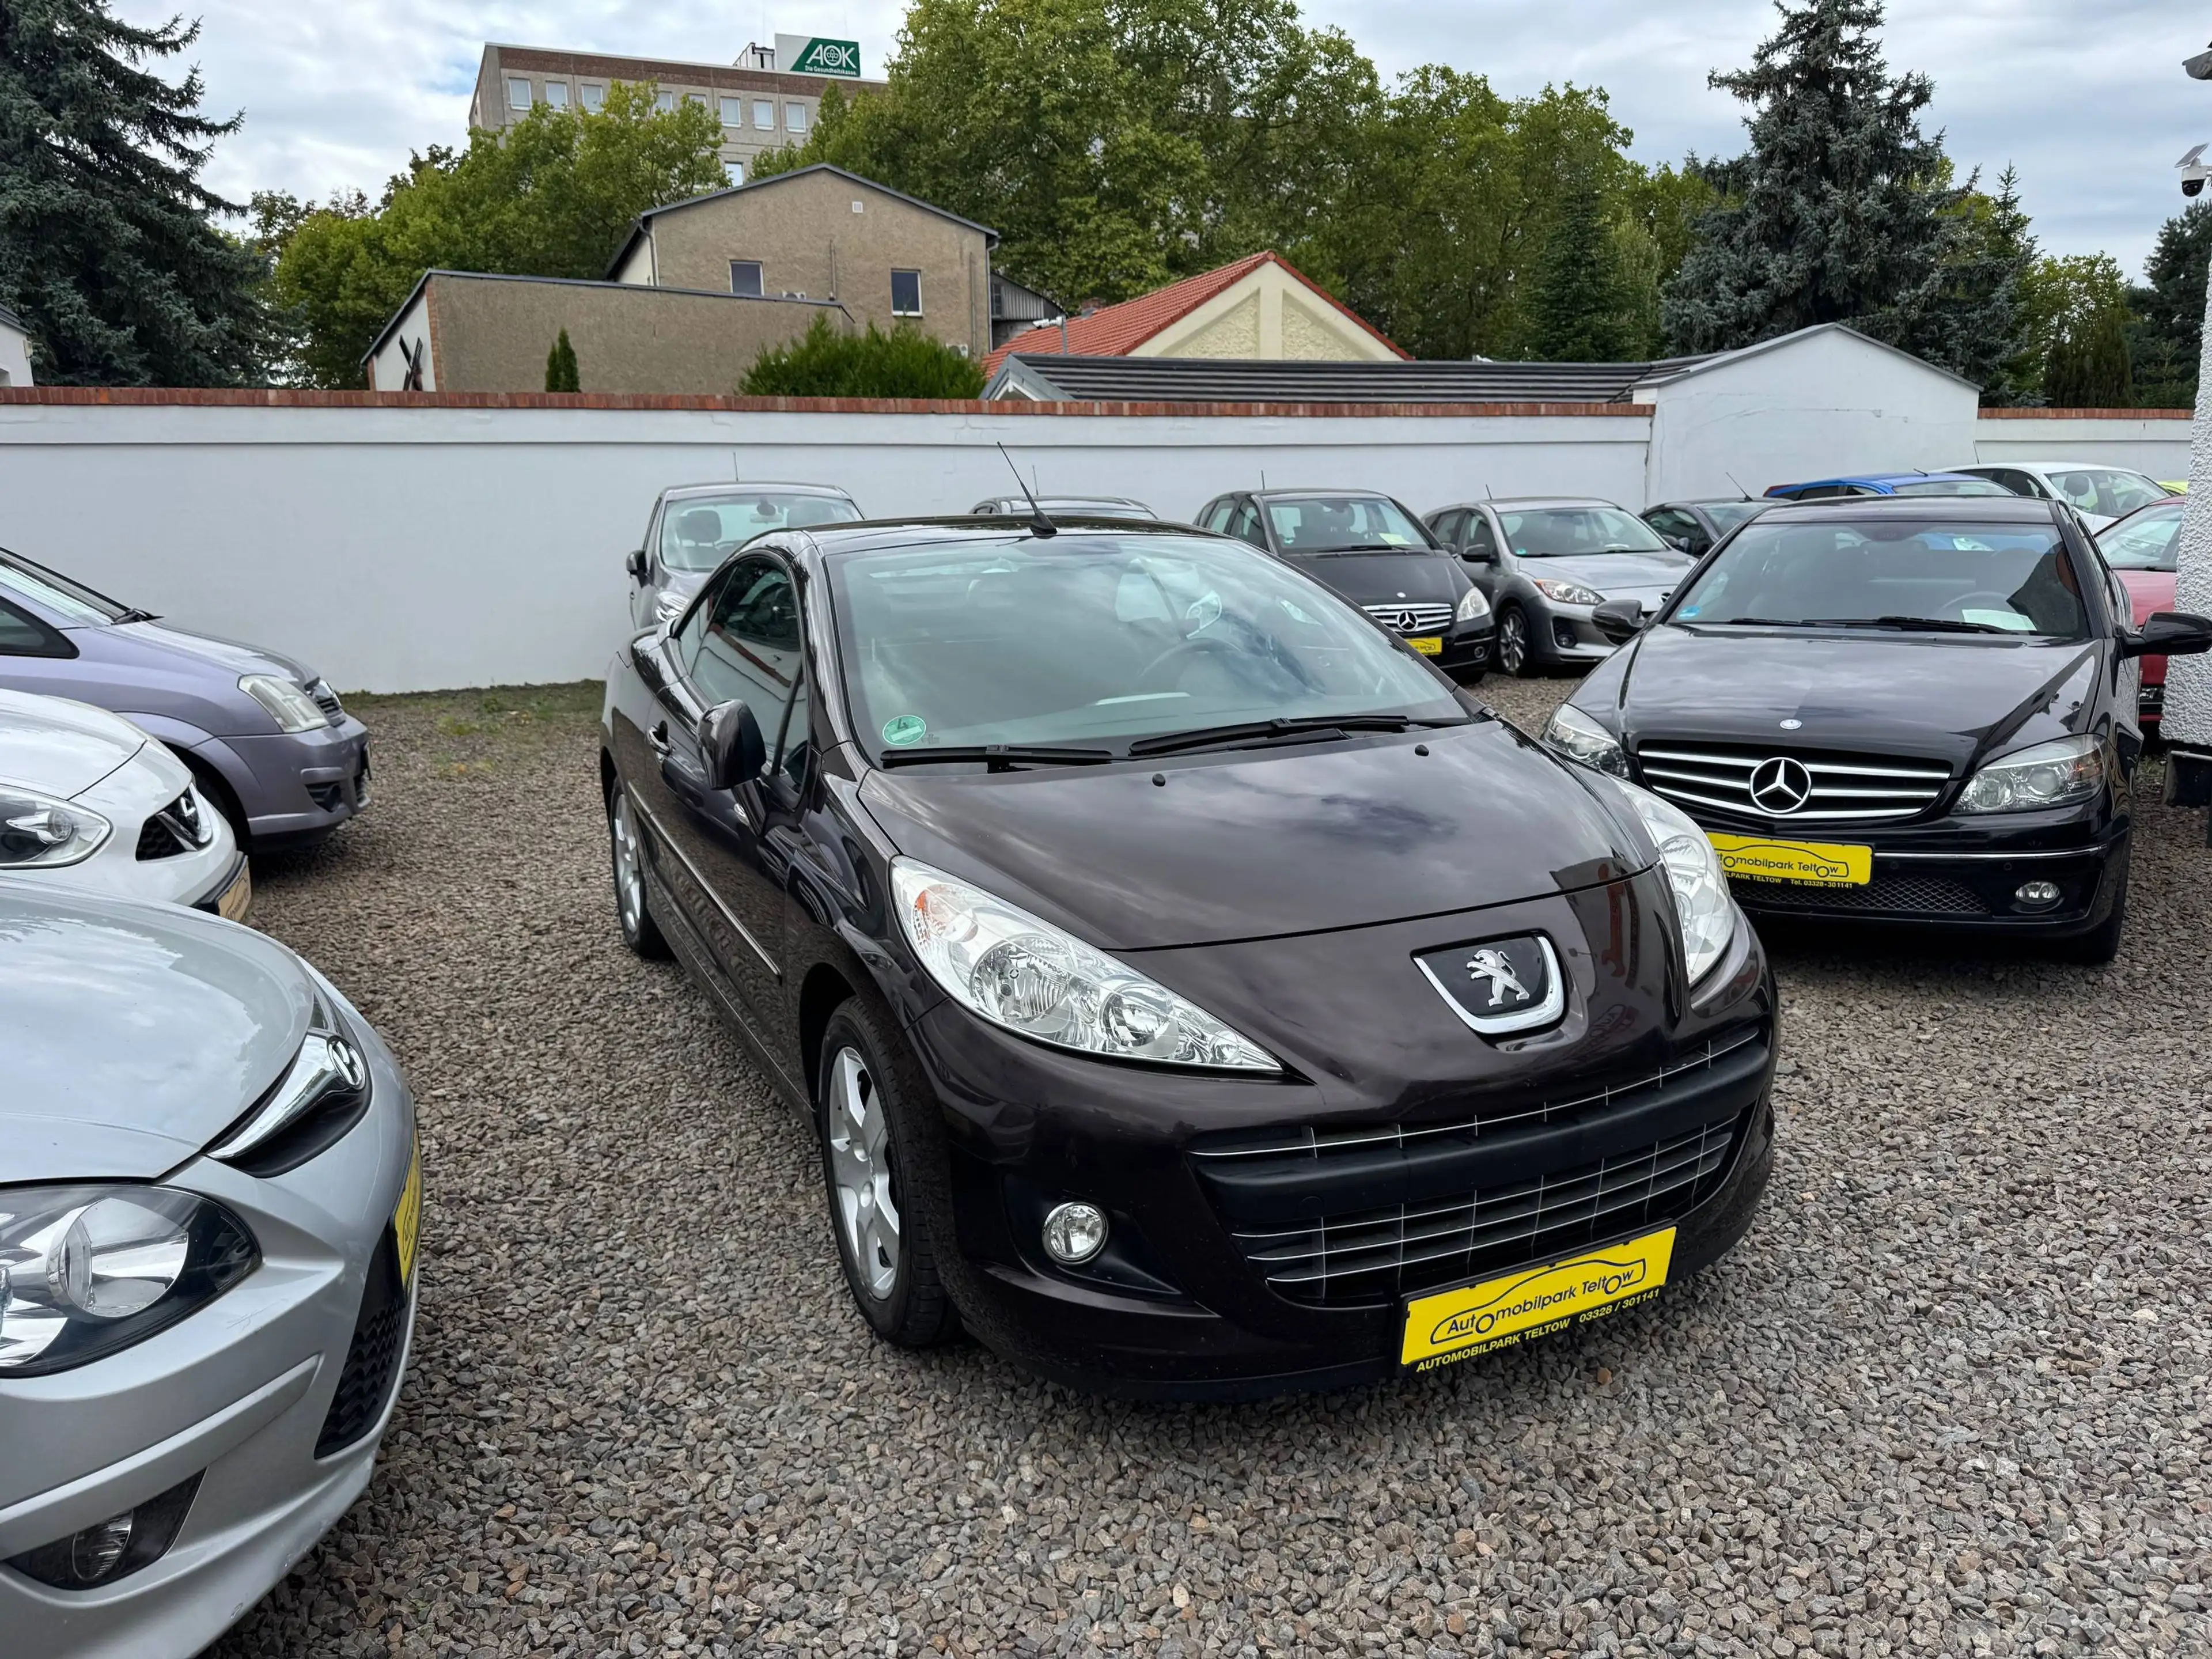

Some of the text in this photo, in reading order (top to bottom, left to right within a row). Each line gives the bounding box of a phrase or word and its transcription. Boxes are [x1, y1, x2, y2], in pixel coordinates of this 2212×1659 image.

[806, 44, 857, 69] AOK
[1752, 875, 1782, 884] TELTOW
[1415, 1333, 1521, 1373] AUTOMOBILPARK
[1524, 1317, 1571, 1341] TELTOW
[1579, 1305, 1613, 1324] 03328
[1622, 1288, 1660, 1310] 301141
